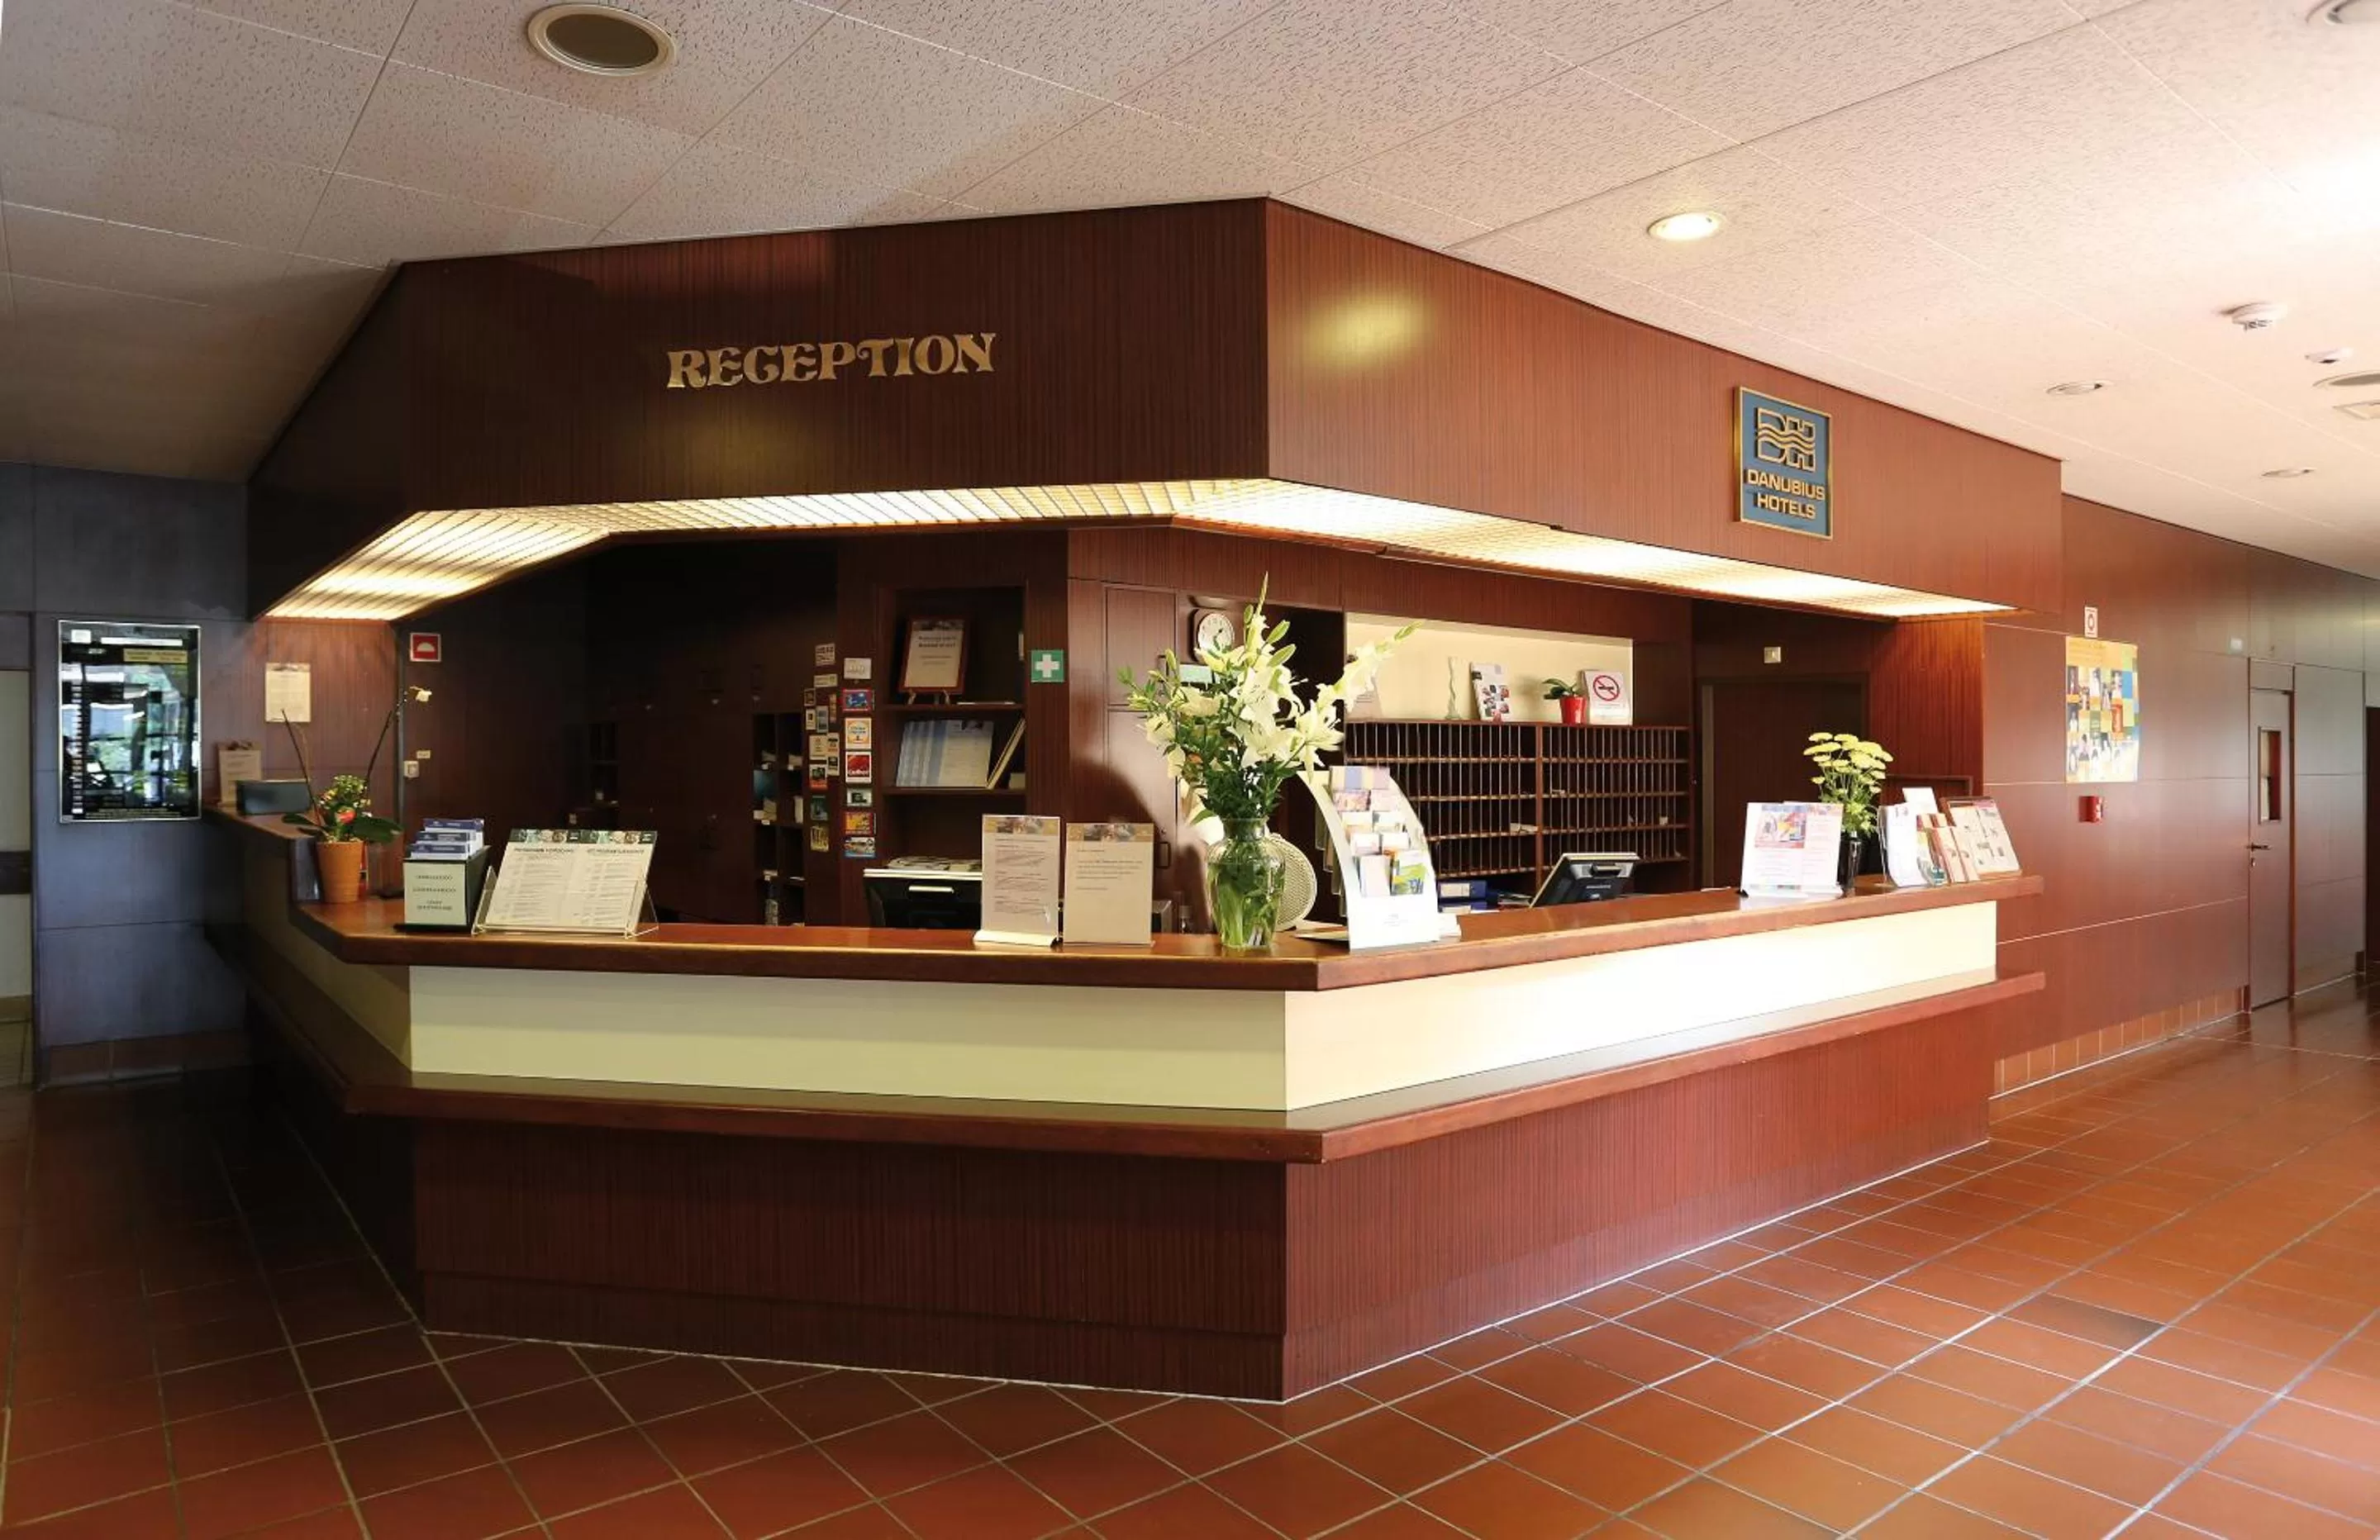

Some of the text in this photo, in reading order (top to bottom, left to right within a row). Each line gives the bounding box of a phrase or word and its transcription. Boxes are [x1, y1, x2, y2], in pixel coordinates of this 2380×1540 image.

[666, 332, 997, 388] RECEPTION
[1748, 469, 1825, 500] DANUBIUS
[1757, 493, 1816, 519] HOTELS
